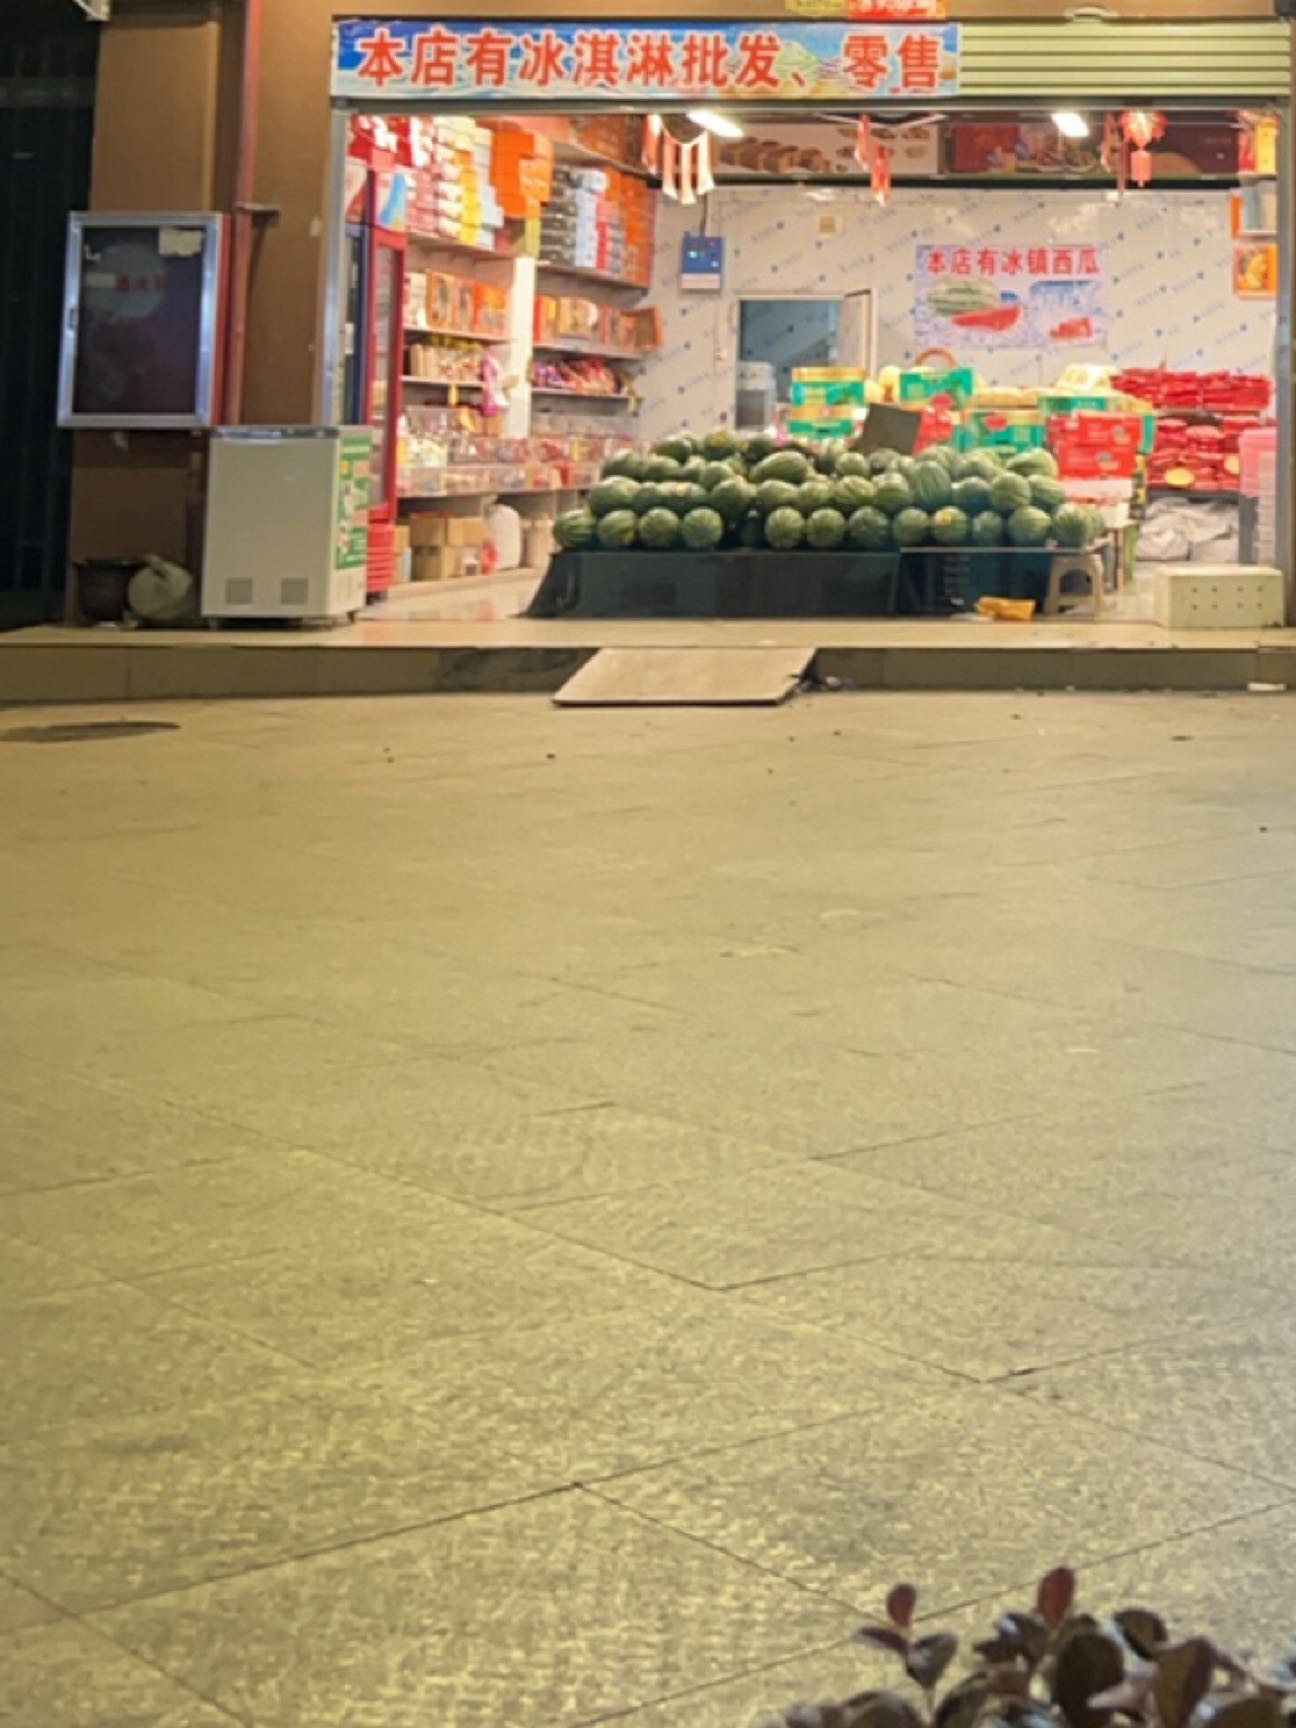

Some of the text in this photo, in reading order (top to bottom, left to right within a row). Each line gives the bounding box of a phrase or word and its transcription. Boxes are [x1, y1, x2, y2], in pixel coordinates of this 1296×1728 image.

[357, 28, 940, 89] 本店有冰淇淋批发、零售
[927, 246, 1101, 275] 本店有冰镇西瓜
